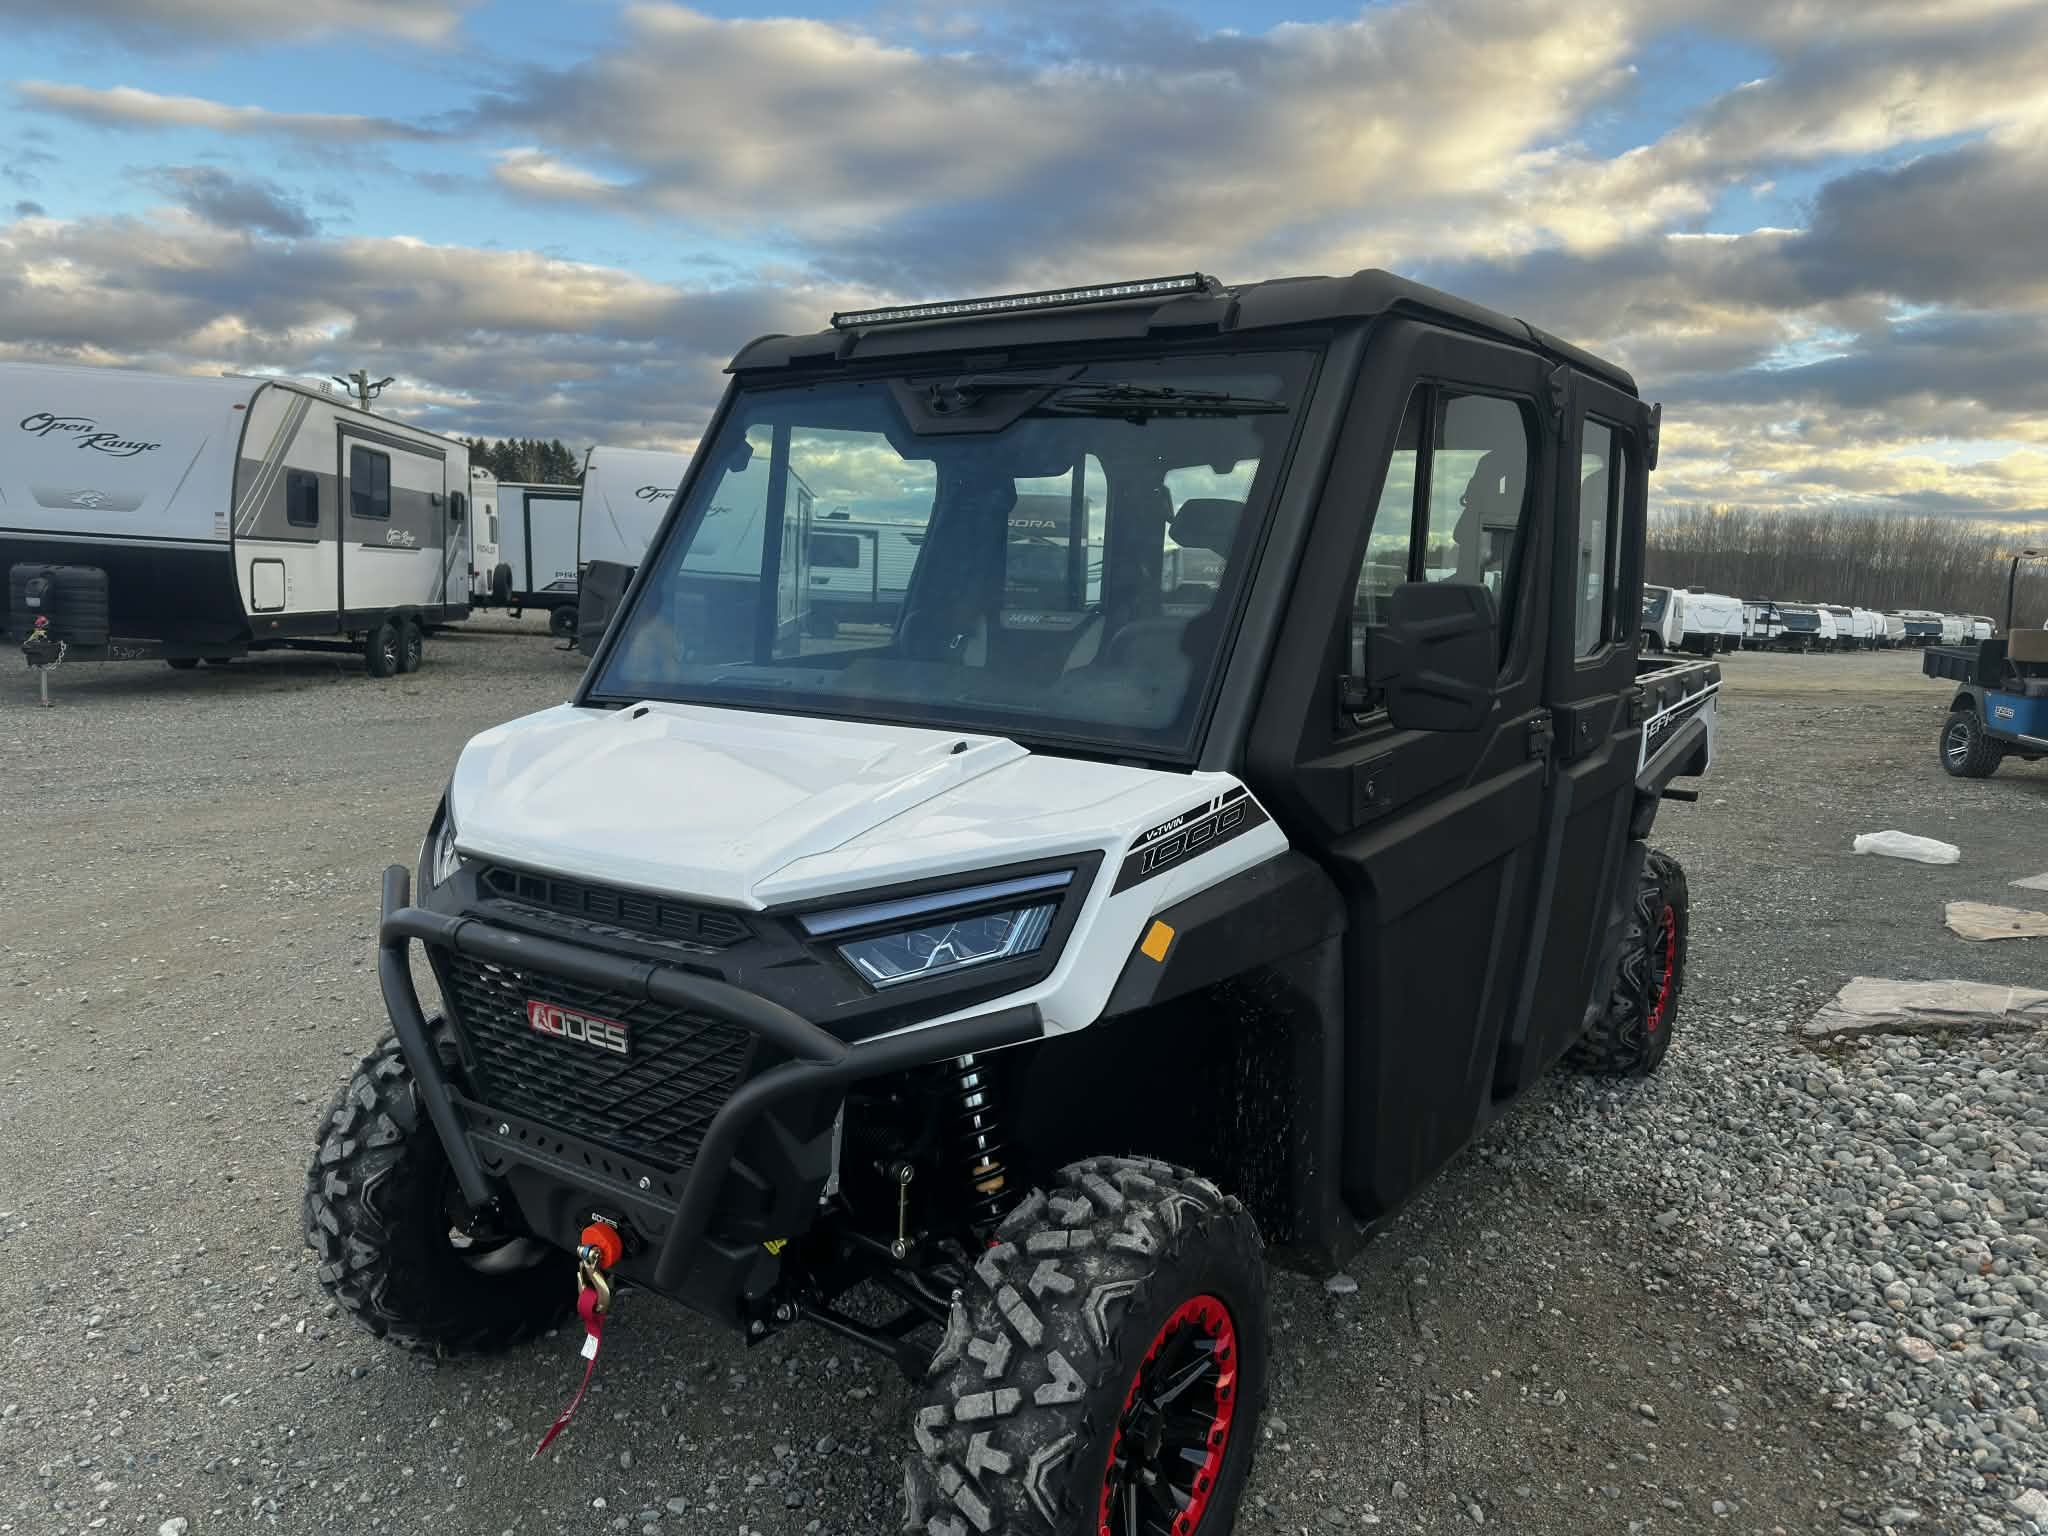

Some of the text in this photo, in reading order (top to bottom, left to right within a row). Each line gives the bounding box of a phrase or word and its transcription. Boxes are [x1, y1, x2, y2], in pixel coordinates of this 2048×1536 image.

[20, 413, 97, 437] Open
[72, 433, 161, 457] Range
[636, 486, 677, 504] Ope
[1141, 800, 1247, 875] 1000
[1146, 816, 1184, 841] V-TWIN
[533, 1006, 628, 1054] AODES
